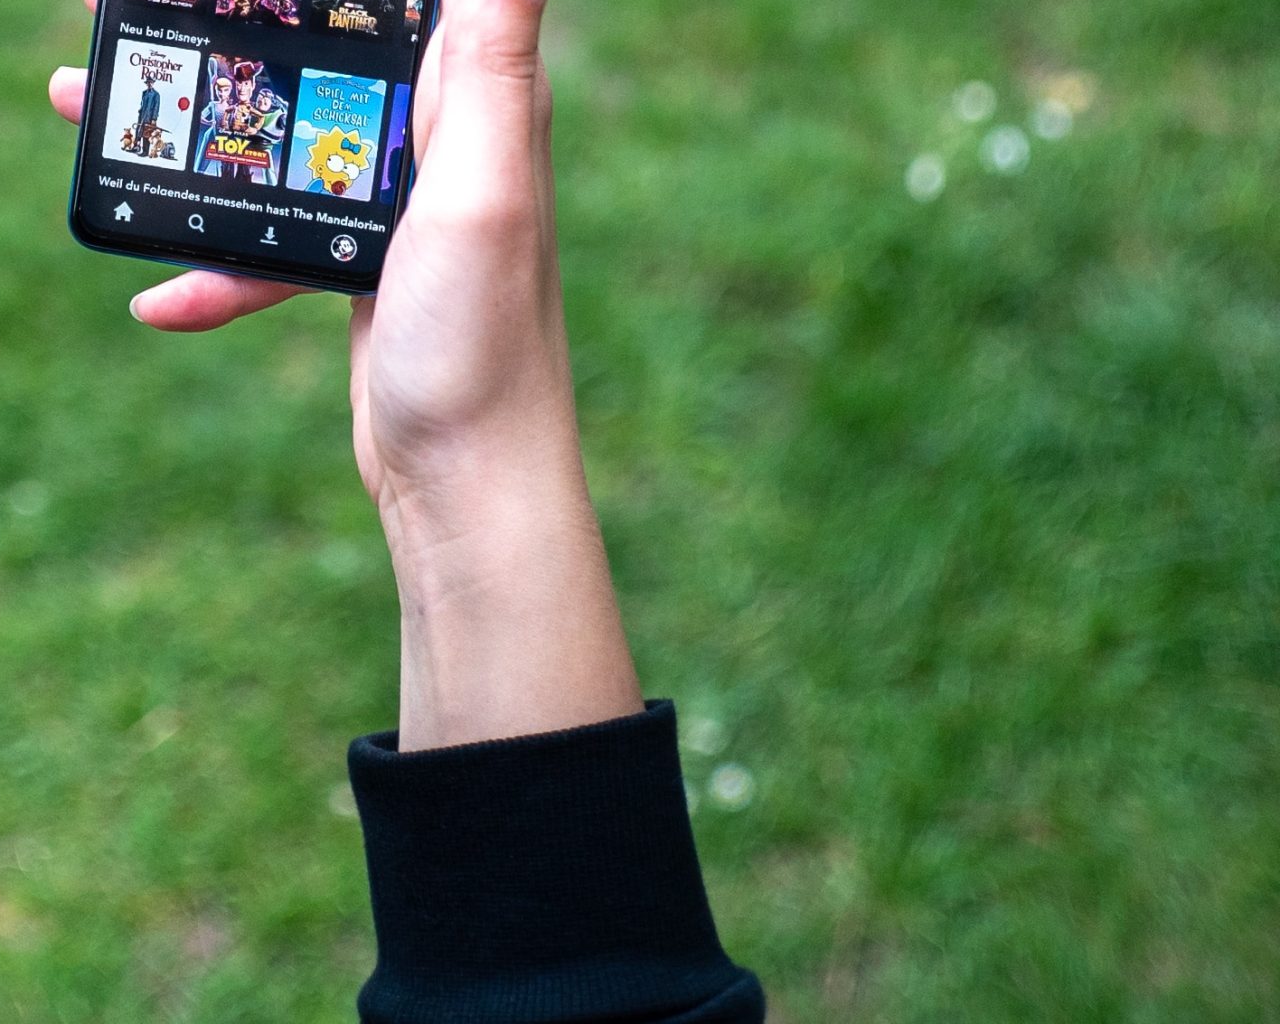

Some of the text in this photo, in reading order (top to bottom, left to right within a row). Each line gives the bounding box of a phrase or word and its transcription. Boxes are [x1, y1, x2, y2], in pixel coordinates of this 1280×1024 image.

[328, 10, 378, 33] PANTHER
[339, 6, 369, 17] BLACK
[120, 22, 211, 47] Neu bei Disney+
[129, 52, 183, 72] Christopher
[141, 66, 173, 84] Robin
[316, 85, 371, 104] SPIEL MIT
[332, 99, 352, 111] DEM
[313, 107, 370, 127] SCHICKSAL
[215, 136, 251, 155] TOY
[244, 149, 268, 158] STORY
[99, 175, 123, 189] Weil
[125, 180, 140, 191] du
[266, 203, 289, 217] hast
[292, 208, 313, 221] The
[316, 212, 386, 233] Mandalorian
